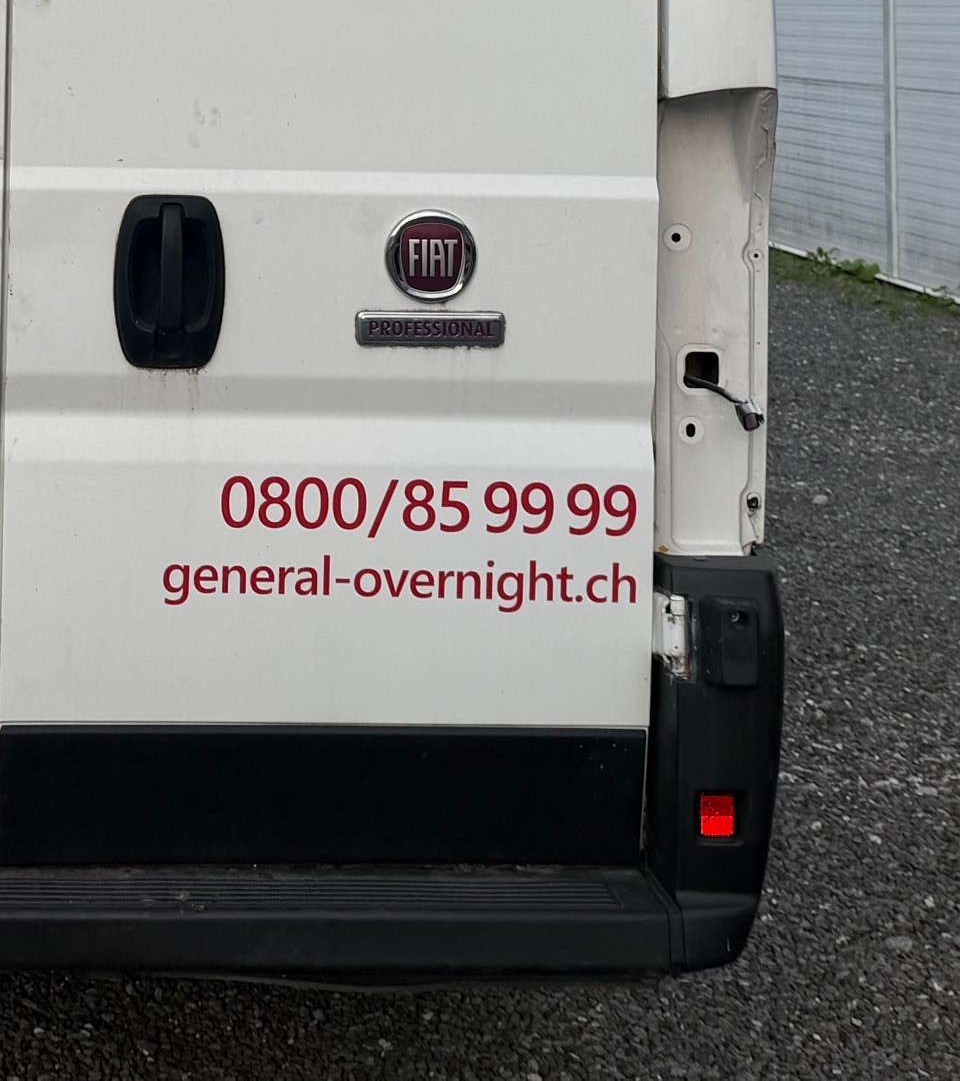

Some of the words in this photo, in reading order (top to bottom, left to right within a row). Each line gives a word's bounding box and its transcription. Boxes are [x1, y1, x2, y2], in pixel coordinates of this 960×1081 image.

[408, 238, 458, 278] FIAT
[368, 320, 495, 338] PROFESSIONAL
[162, 554, 638, 613] general-overnight.ch
